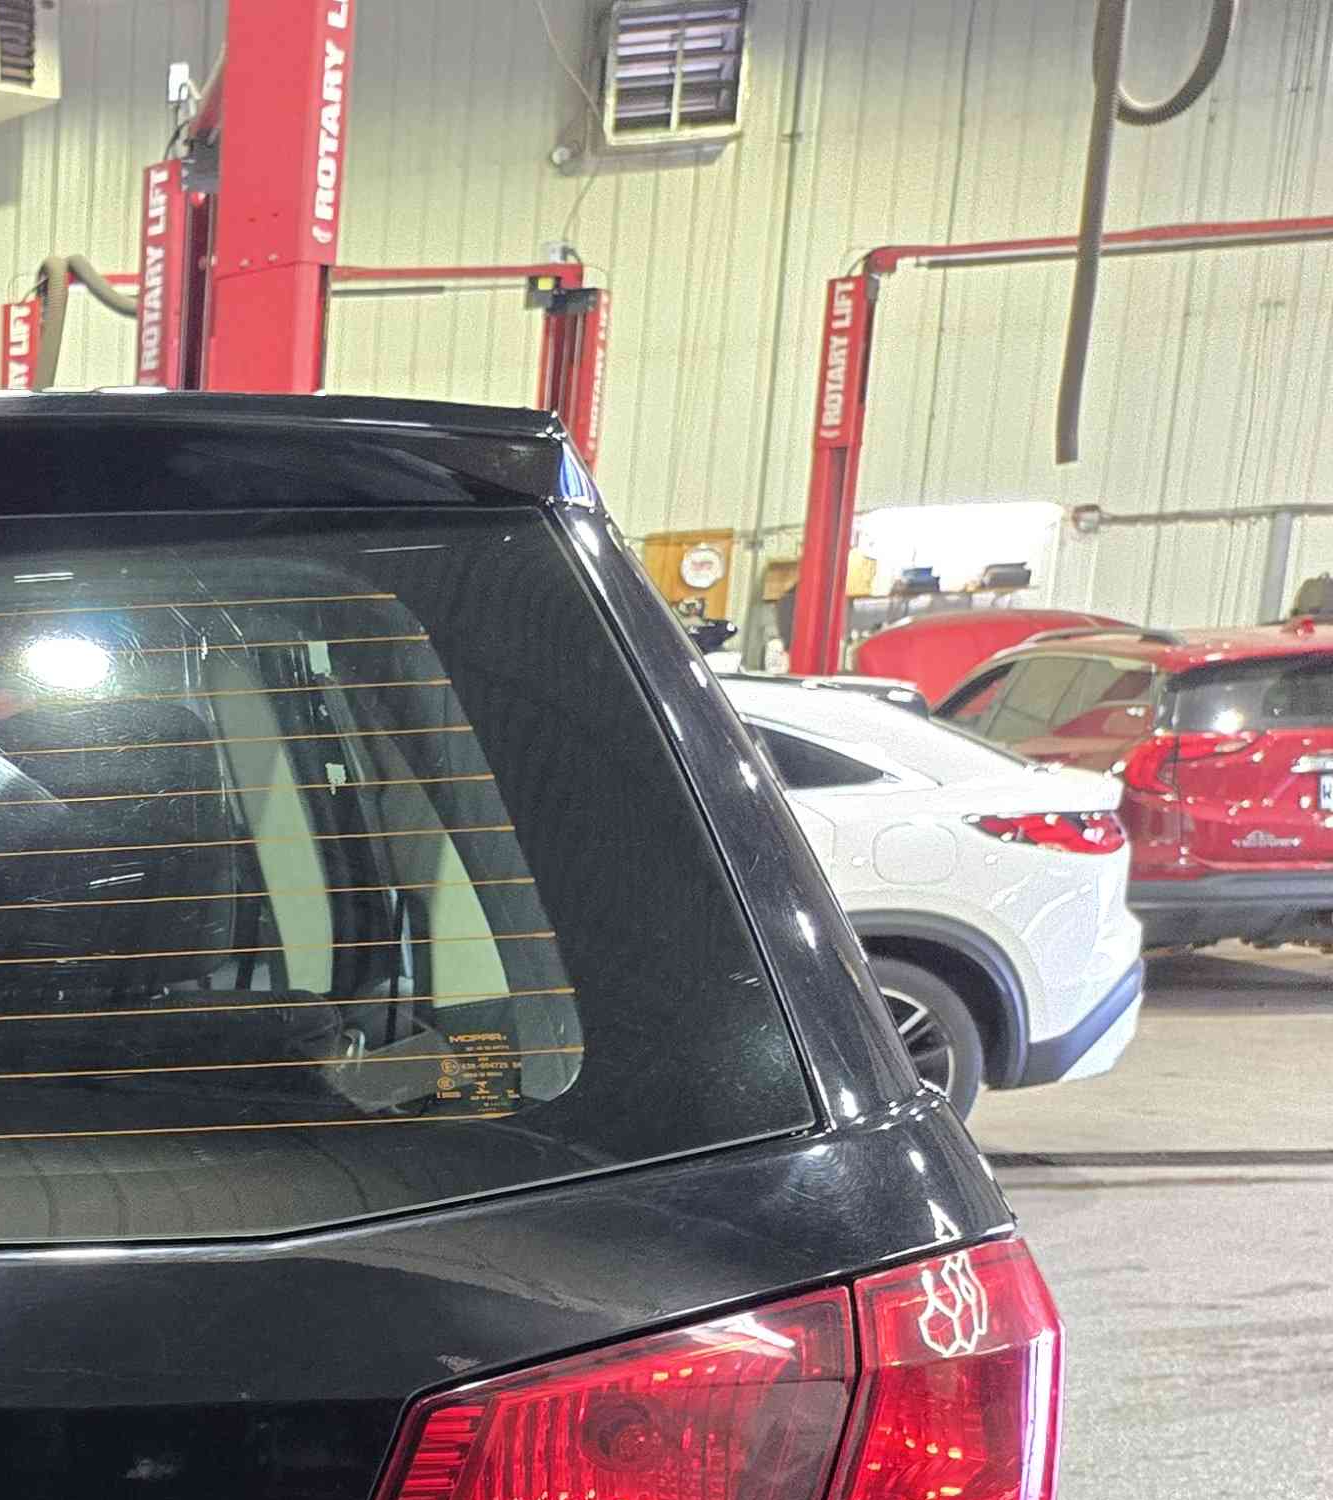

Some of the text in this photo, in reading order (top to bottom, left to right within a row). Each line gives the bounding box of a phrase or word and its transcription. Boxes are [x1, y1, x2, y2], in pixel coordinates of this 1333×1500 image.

[314, 37, 346, 221] ROTARY
[8, 304, 32, 357] LIFT
[140, 166, 170, 370] ROTARY LIFT
[821, 280, 856, 427] ROTARY LIFT
